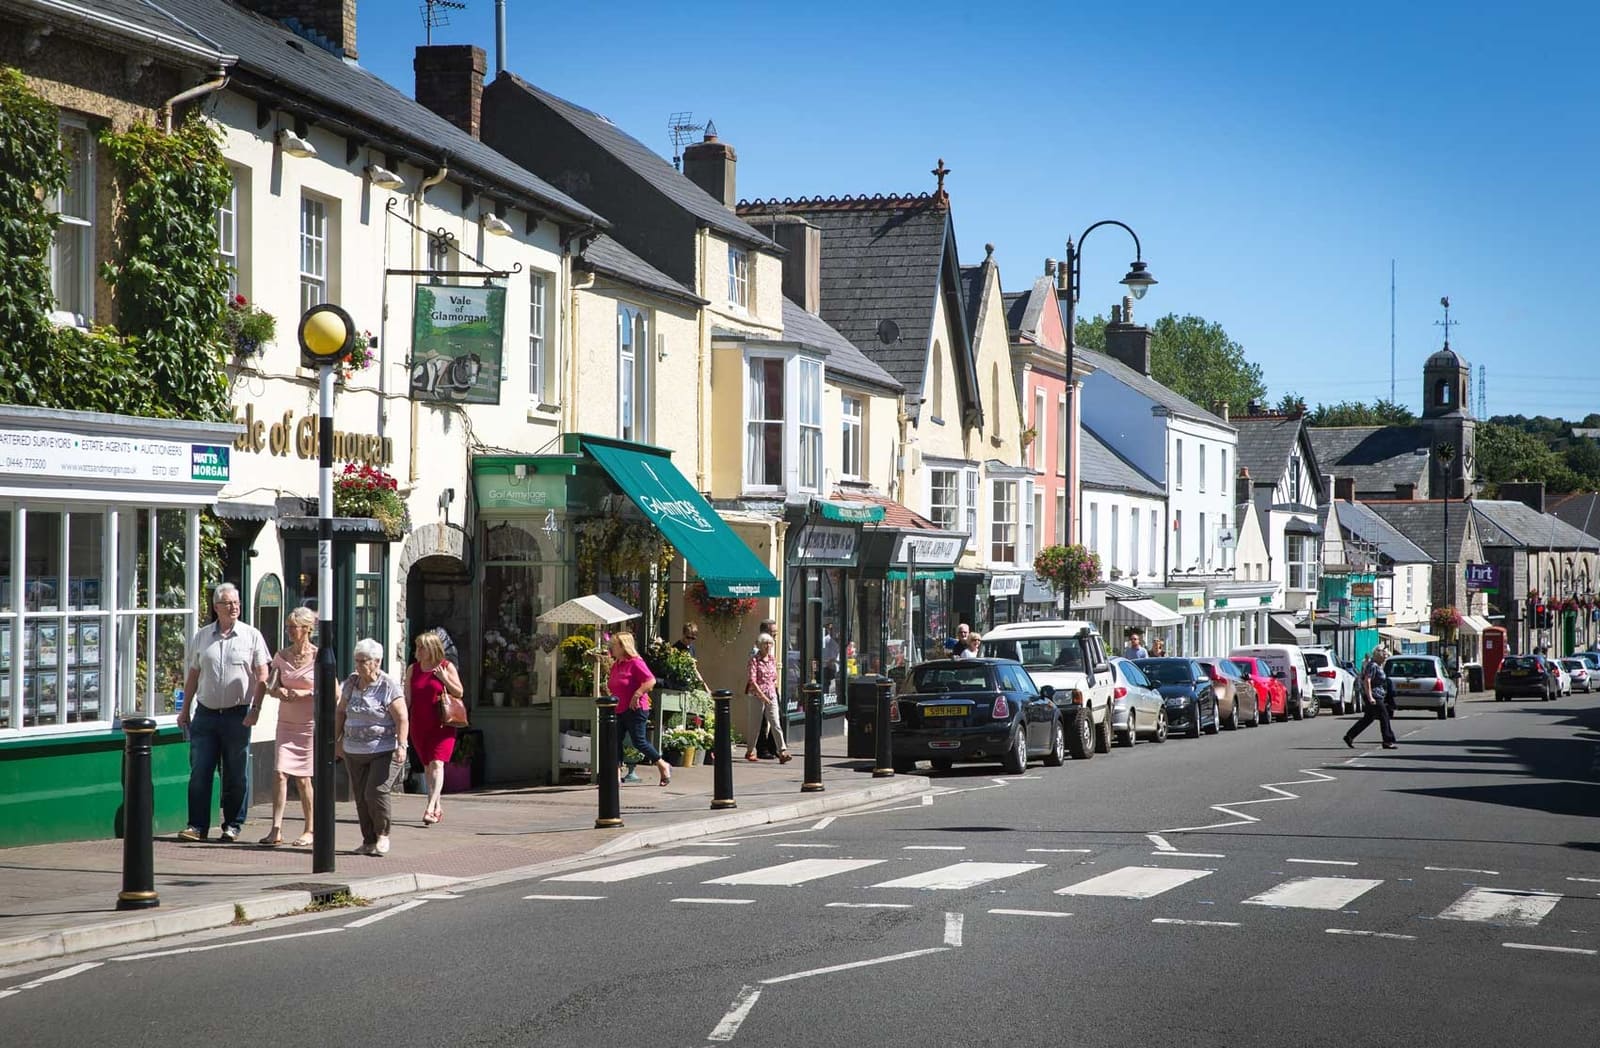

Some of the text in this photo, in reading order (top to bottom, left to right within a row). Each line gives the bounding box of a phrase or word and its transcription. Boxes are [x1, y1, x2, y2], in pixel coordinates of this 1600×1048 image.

[450, 295, 471, 305] Vale
[455, 305, 464, 313] of
[431, 311, 487, 325] Glamorgan
[33, 435, 72, 449] SURVEYORS
[81, 439, 104, 451] ESTATE
[105, 441, 131, 453] AGENTS
[269, 409, 294, 457] of
[296, 413, 394, 468] Glmorgan
[193, 453, 218, 464] WATTS
[192, 464, 228, 477] MORGAN
[1471, 566, 1493, 580] hrt
